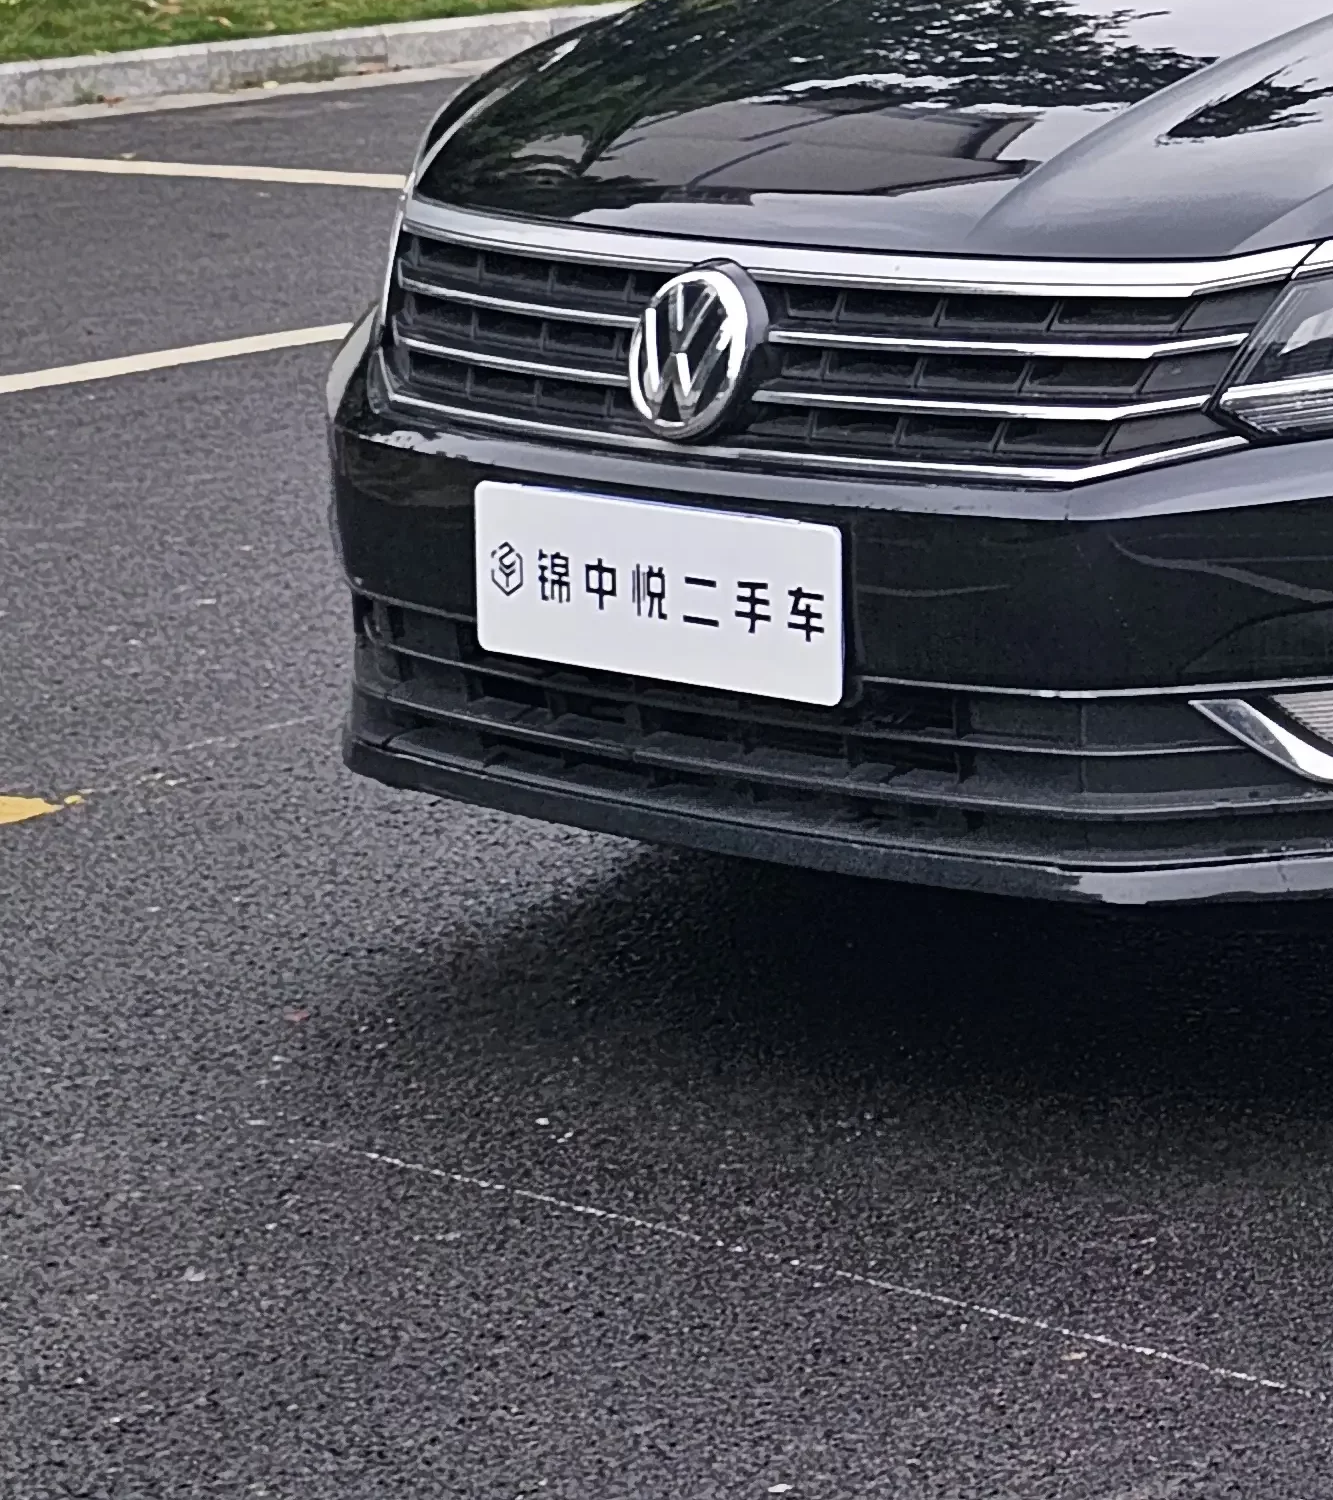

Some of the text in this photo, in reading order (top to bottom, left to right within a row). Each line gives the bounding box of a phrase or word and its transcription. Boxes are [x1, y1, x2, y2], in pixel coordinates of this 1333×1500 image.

[537, 548, 825, 642] 锦中悦二手车
